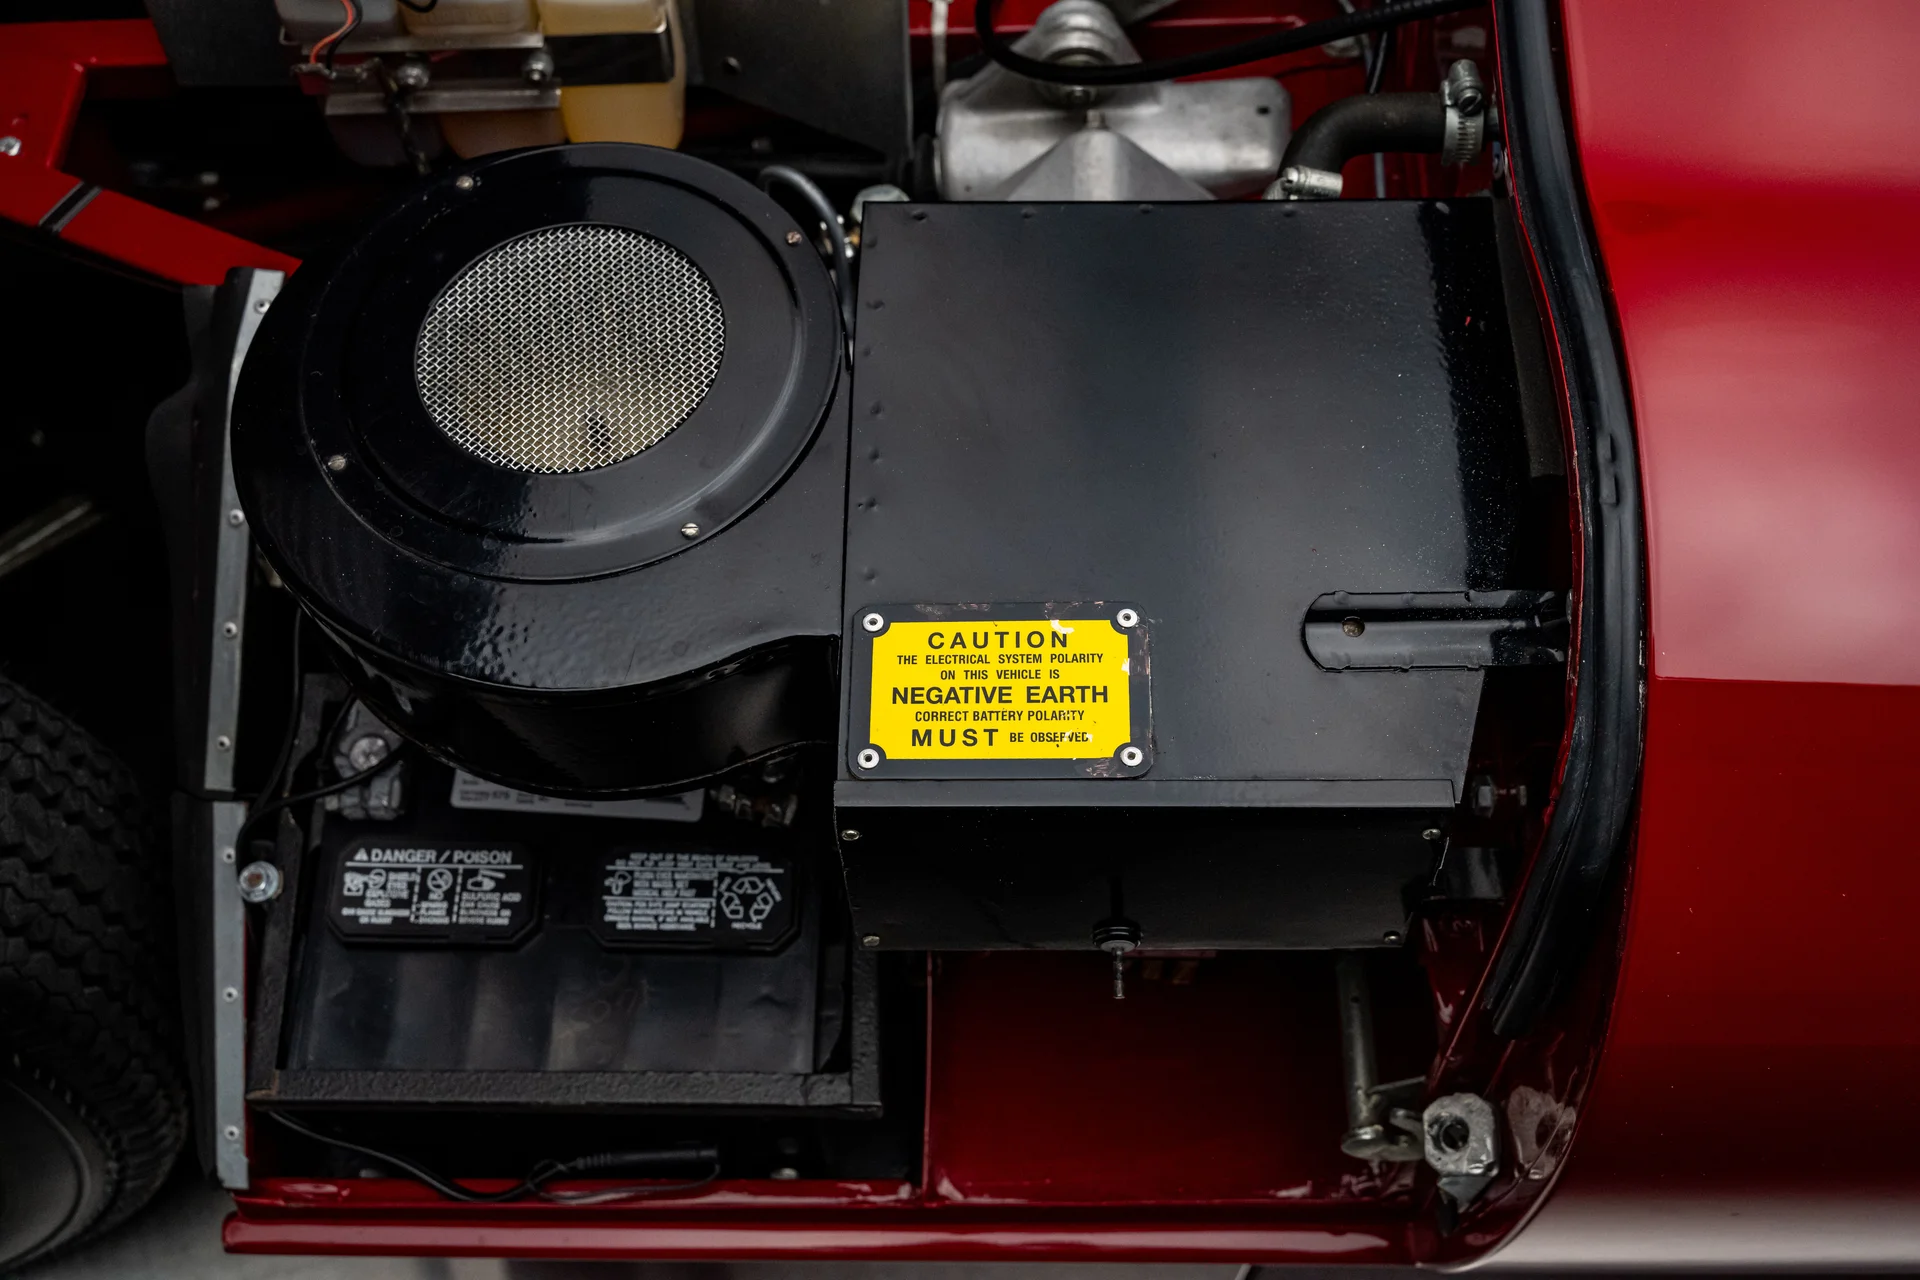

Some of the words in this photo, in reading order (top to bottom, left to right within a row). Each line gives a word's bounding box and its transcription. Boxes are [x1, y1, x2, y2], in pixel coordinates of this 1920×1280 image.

[928, 630, 1068, 650] CAUTION
[897, 655, 918, 665] THE
[925, 654, 991, 665] ELECTRICAL
[998, 653, 1042, 664] SYSTEM
[1050, 653, 1103, 664] POLARITY
[940, 669, 955, 680] ON
[963, 669, 988, 680] THIS
[996, 669, 1041, 680] VEHICLE
[1049, 669, 1060, 679] IS
[892, 686, 1012, 705] NEGATIVE
[1026, 685, 1108, 703] EARTH
[915, 711, 968, 722] CORRECT
[973, 710, 1023, 721] BATTERY
[1027, 710, 1085, 721] POLARITY
[911, 728, 999, 747] MUST
[1009, 732, 1024, 743] BE
[371, 848, 437, 863] DANGER
[453, 850, 513, 864] POISON
